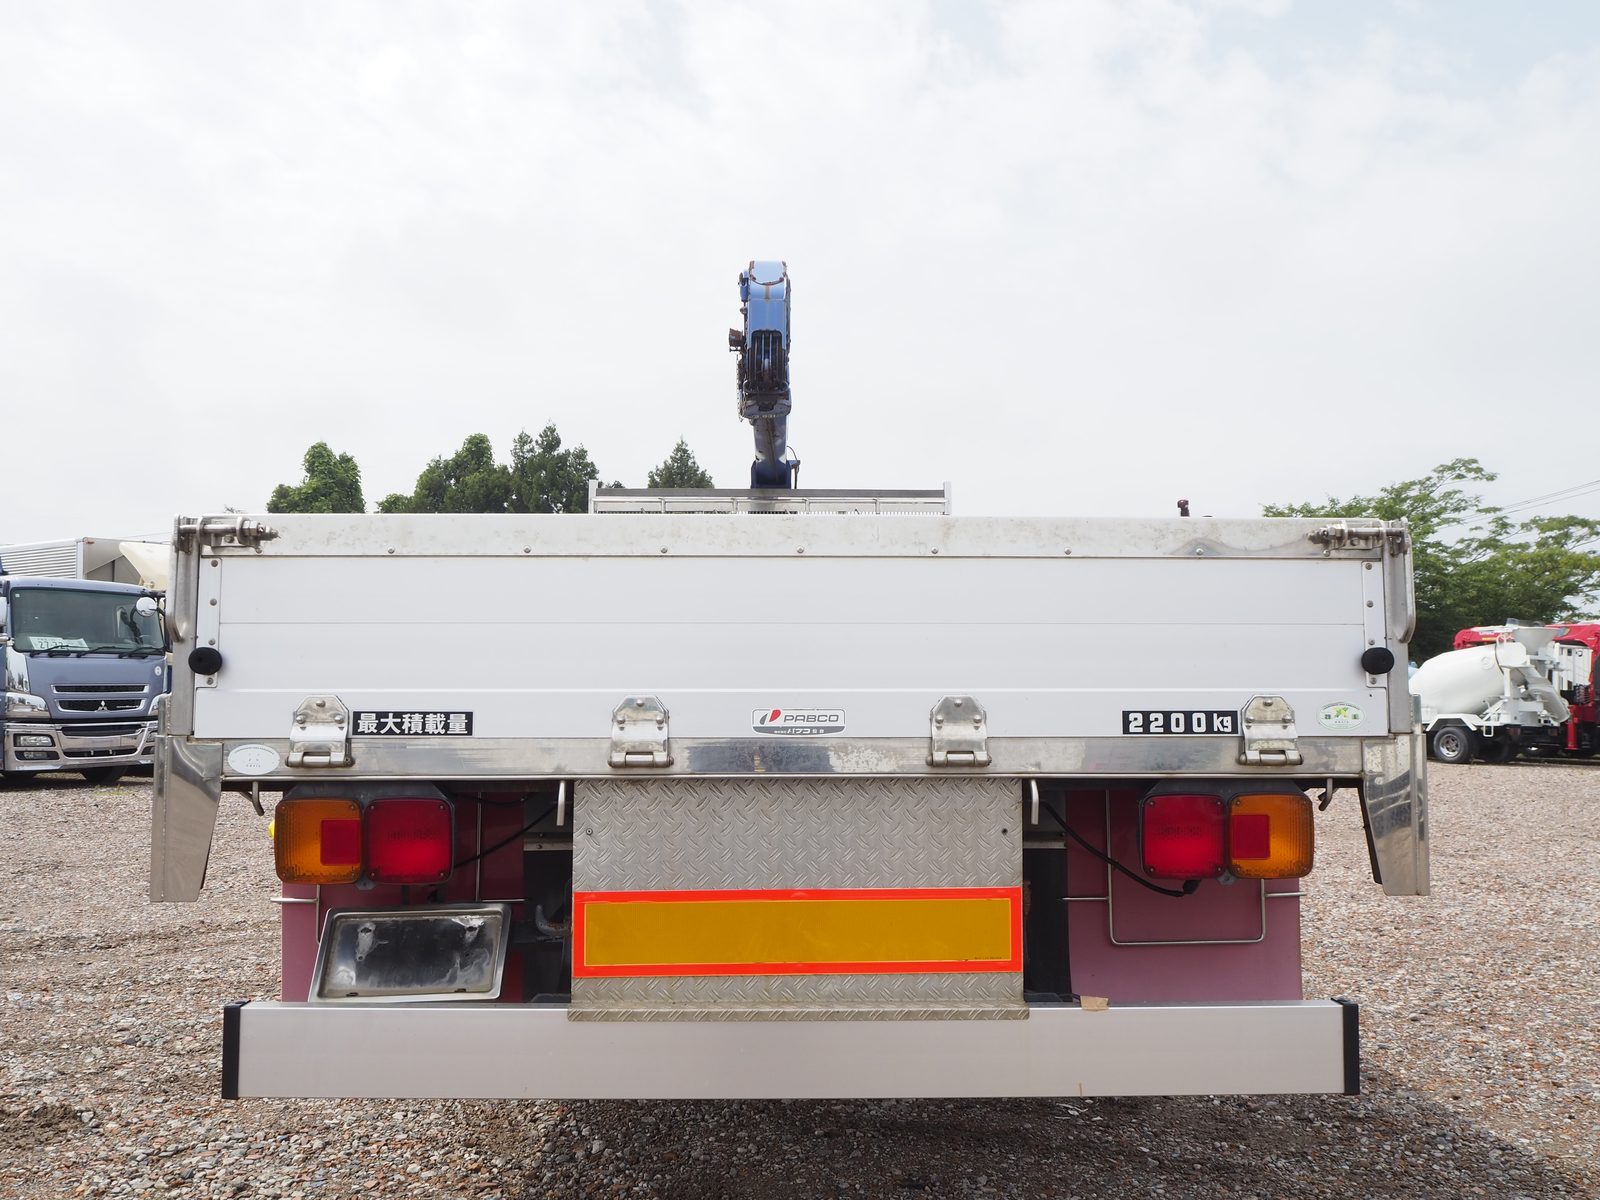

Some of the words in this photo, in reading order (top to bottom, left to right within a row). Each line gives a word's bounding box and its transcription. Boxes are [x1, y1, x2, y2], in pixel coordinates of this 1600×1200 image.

[357, 713, 468, 734] 最大積載量
[784, 714, 839, 723] PABCO
